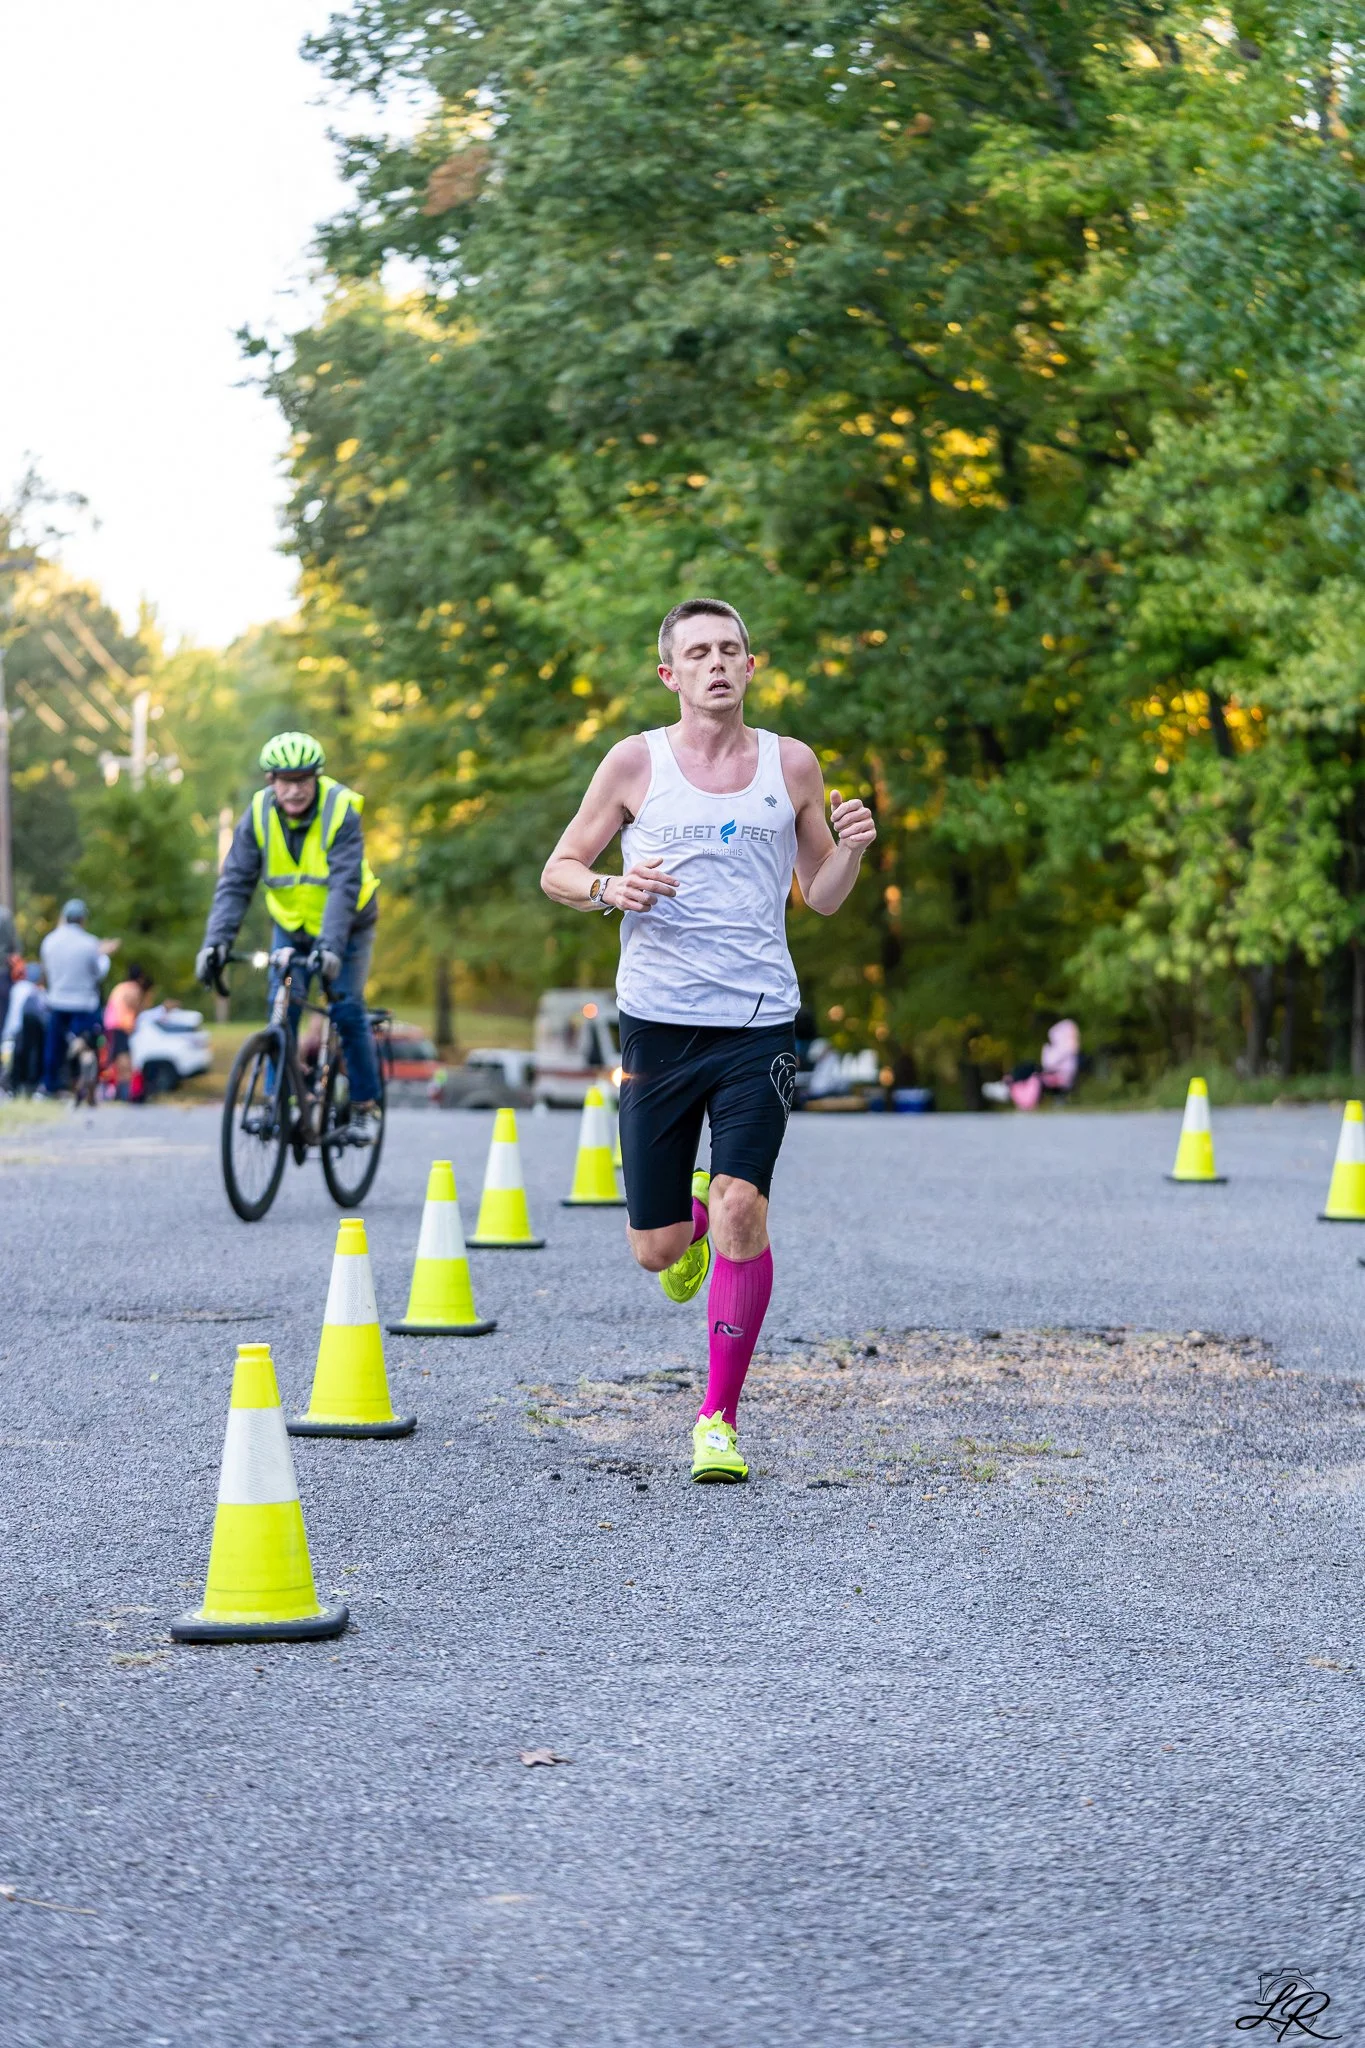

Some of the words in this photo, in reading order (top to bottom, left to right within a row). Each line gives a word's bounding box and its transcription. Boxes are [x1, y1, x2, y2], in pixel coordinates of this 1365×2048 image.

[664, 825, 715, 841] FLEET
[741, 825, 777, 842] FEET
[702, 848, 743, 856] MEMPHIS
